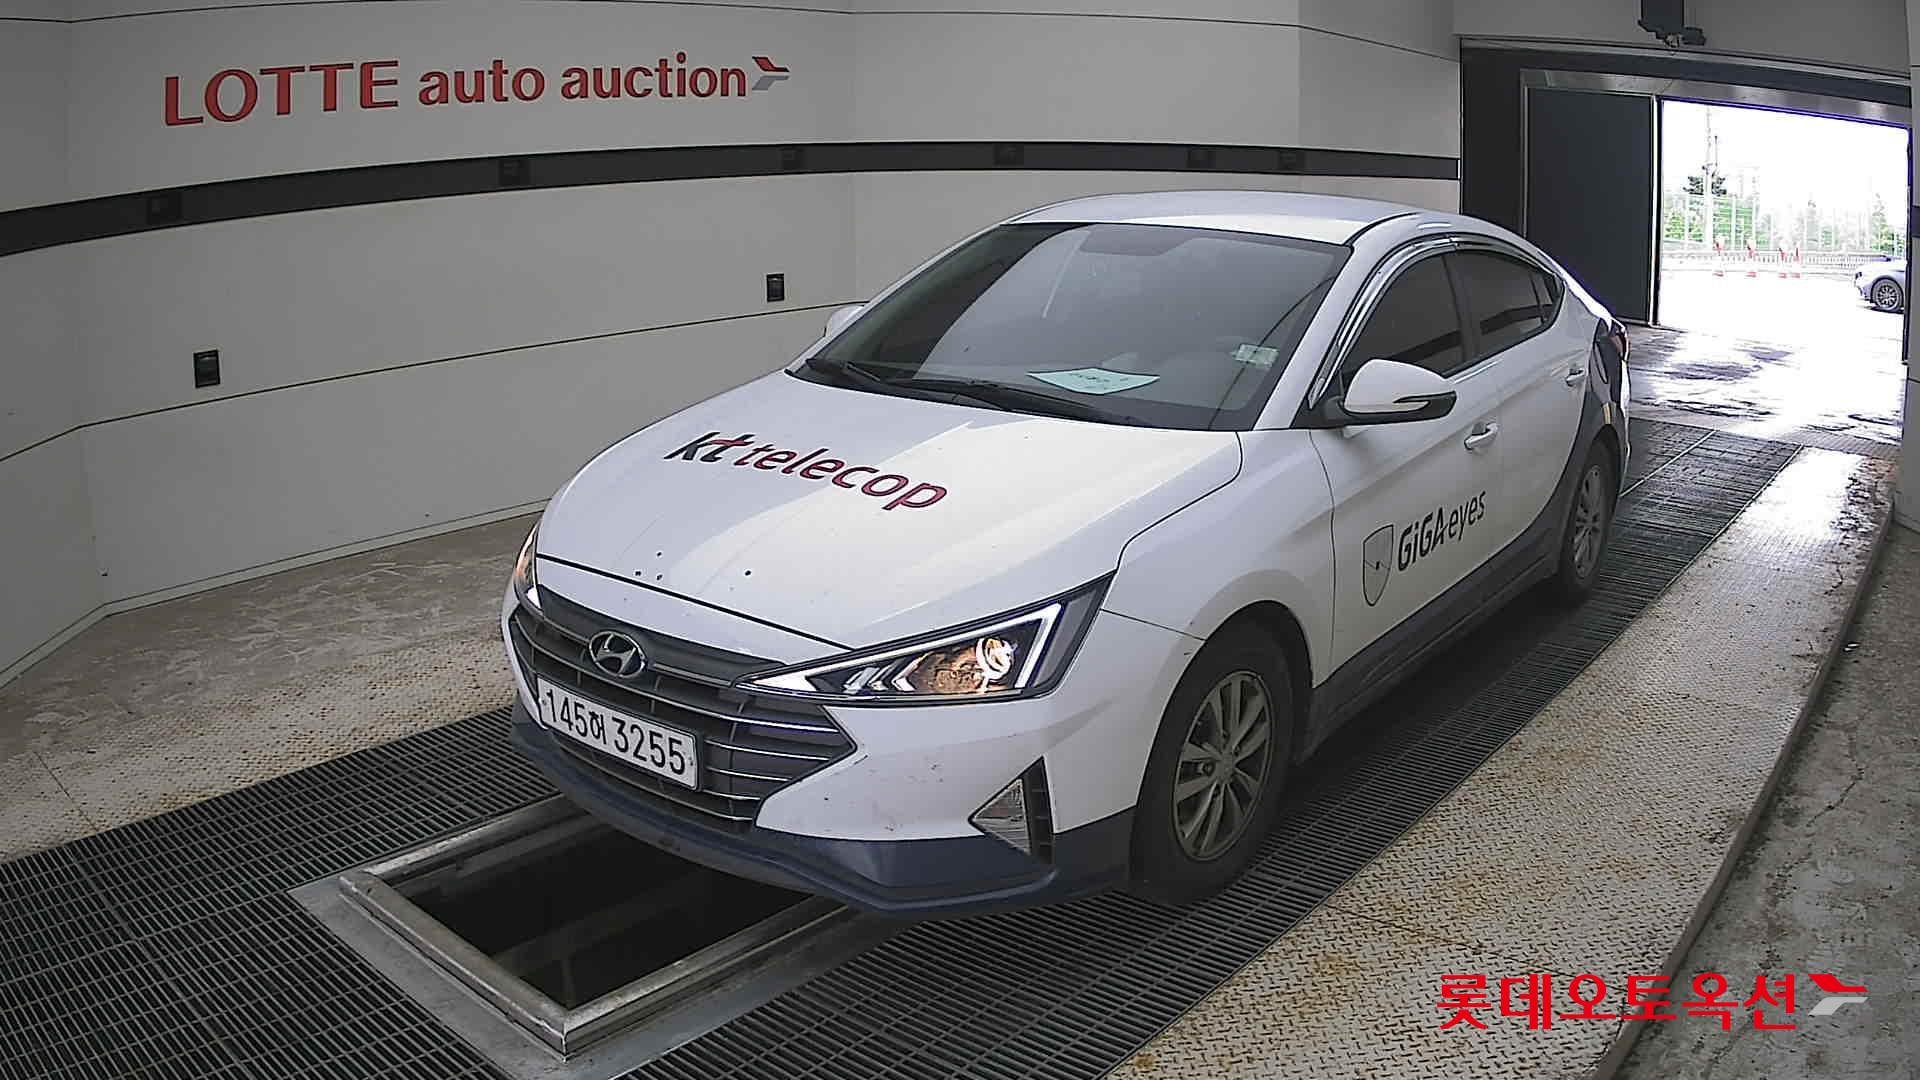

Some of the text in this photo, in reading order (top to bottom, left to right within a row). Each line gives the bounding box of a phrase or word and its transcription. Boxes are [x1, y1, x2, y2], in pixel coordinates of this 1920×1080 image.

[163, 52, 748, 126] LOTTE auto auction
[663, 431, 948, 511] kt telecop
[611, 716, 687, 776] 3255
